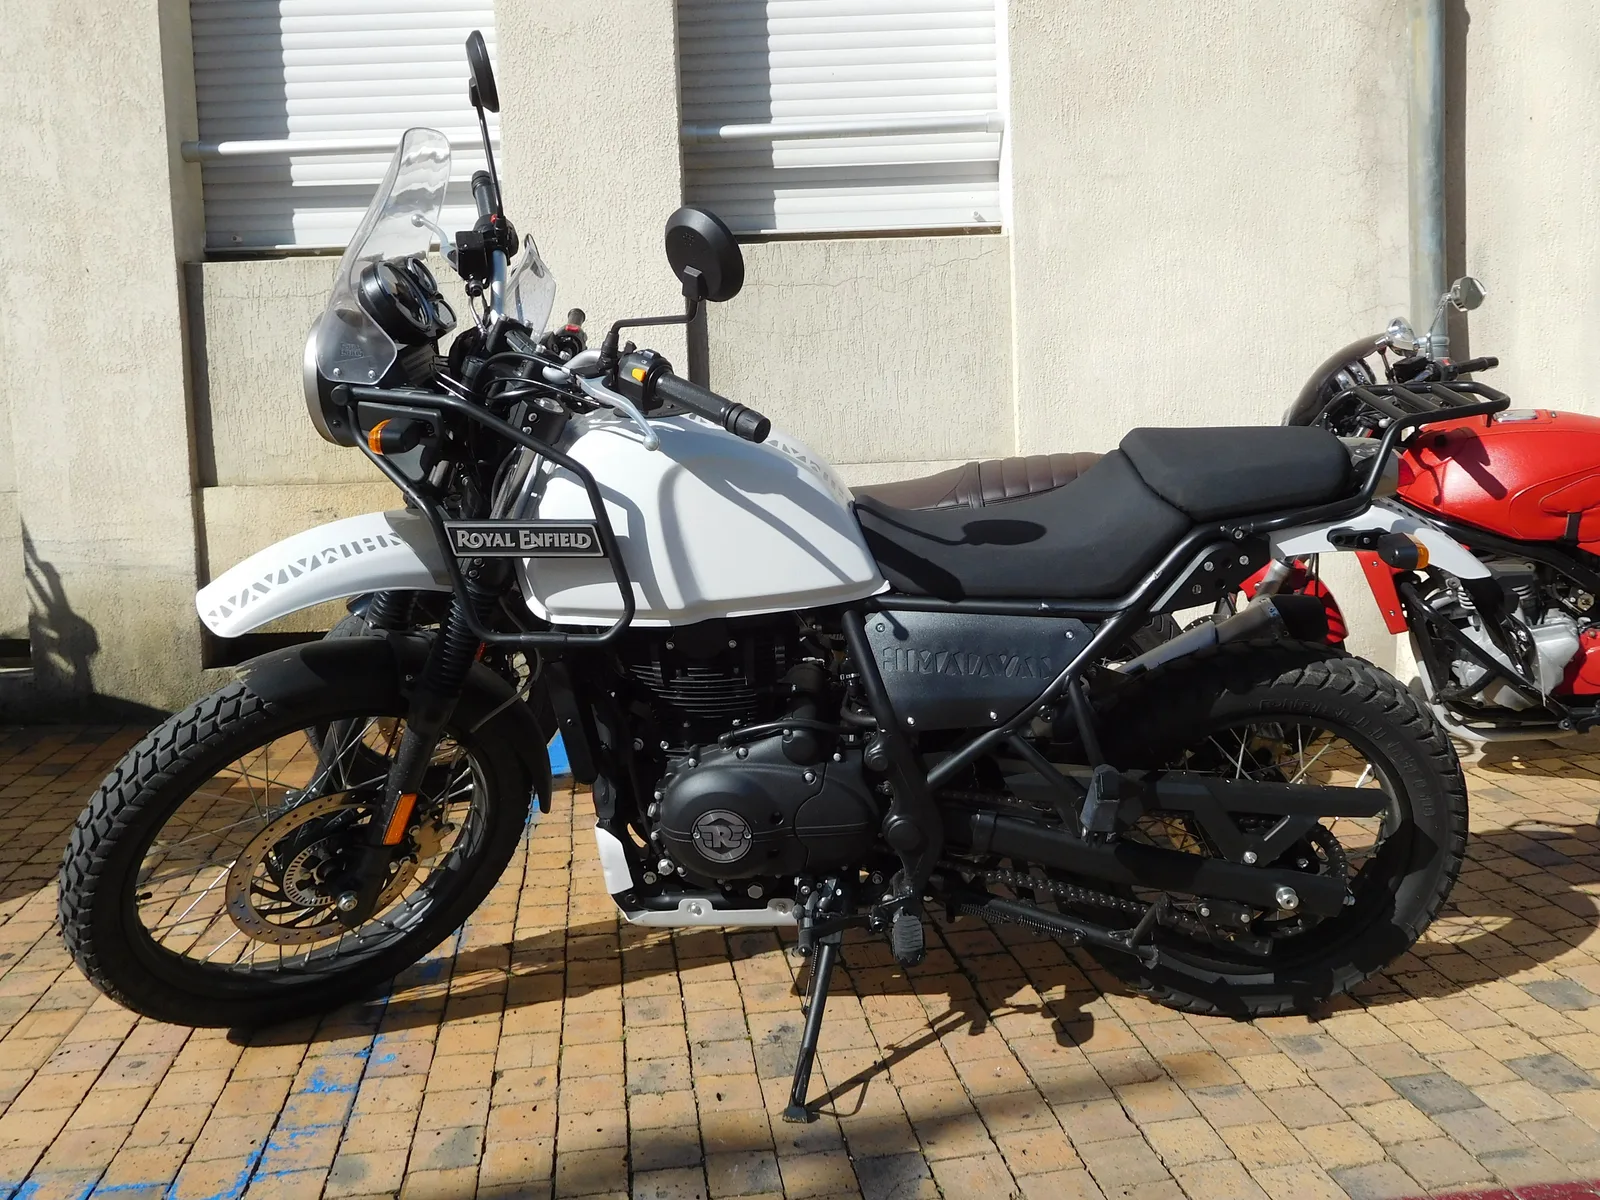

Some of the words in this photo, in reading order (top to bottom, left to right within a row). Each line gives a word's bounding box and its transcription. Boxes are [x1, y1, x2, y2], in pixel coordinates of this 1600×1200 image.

[456, 530, 516, 549] ROYAL
[518, 530, 592, 550] ENFIELD
[882, 645, 1054, 681] HIMALAYAN
